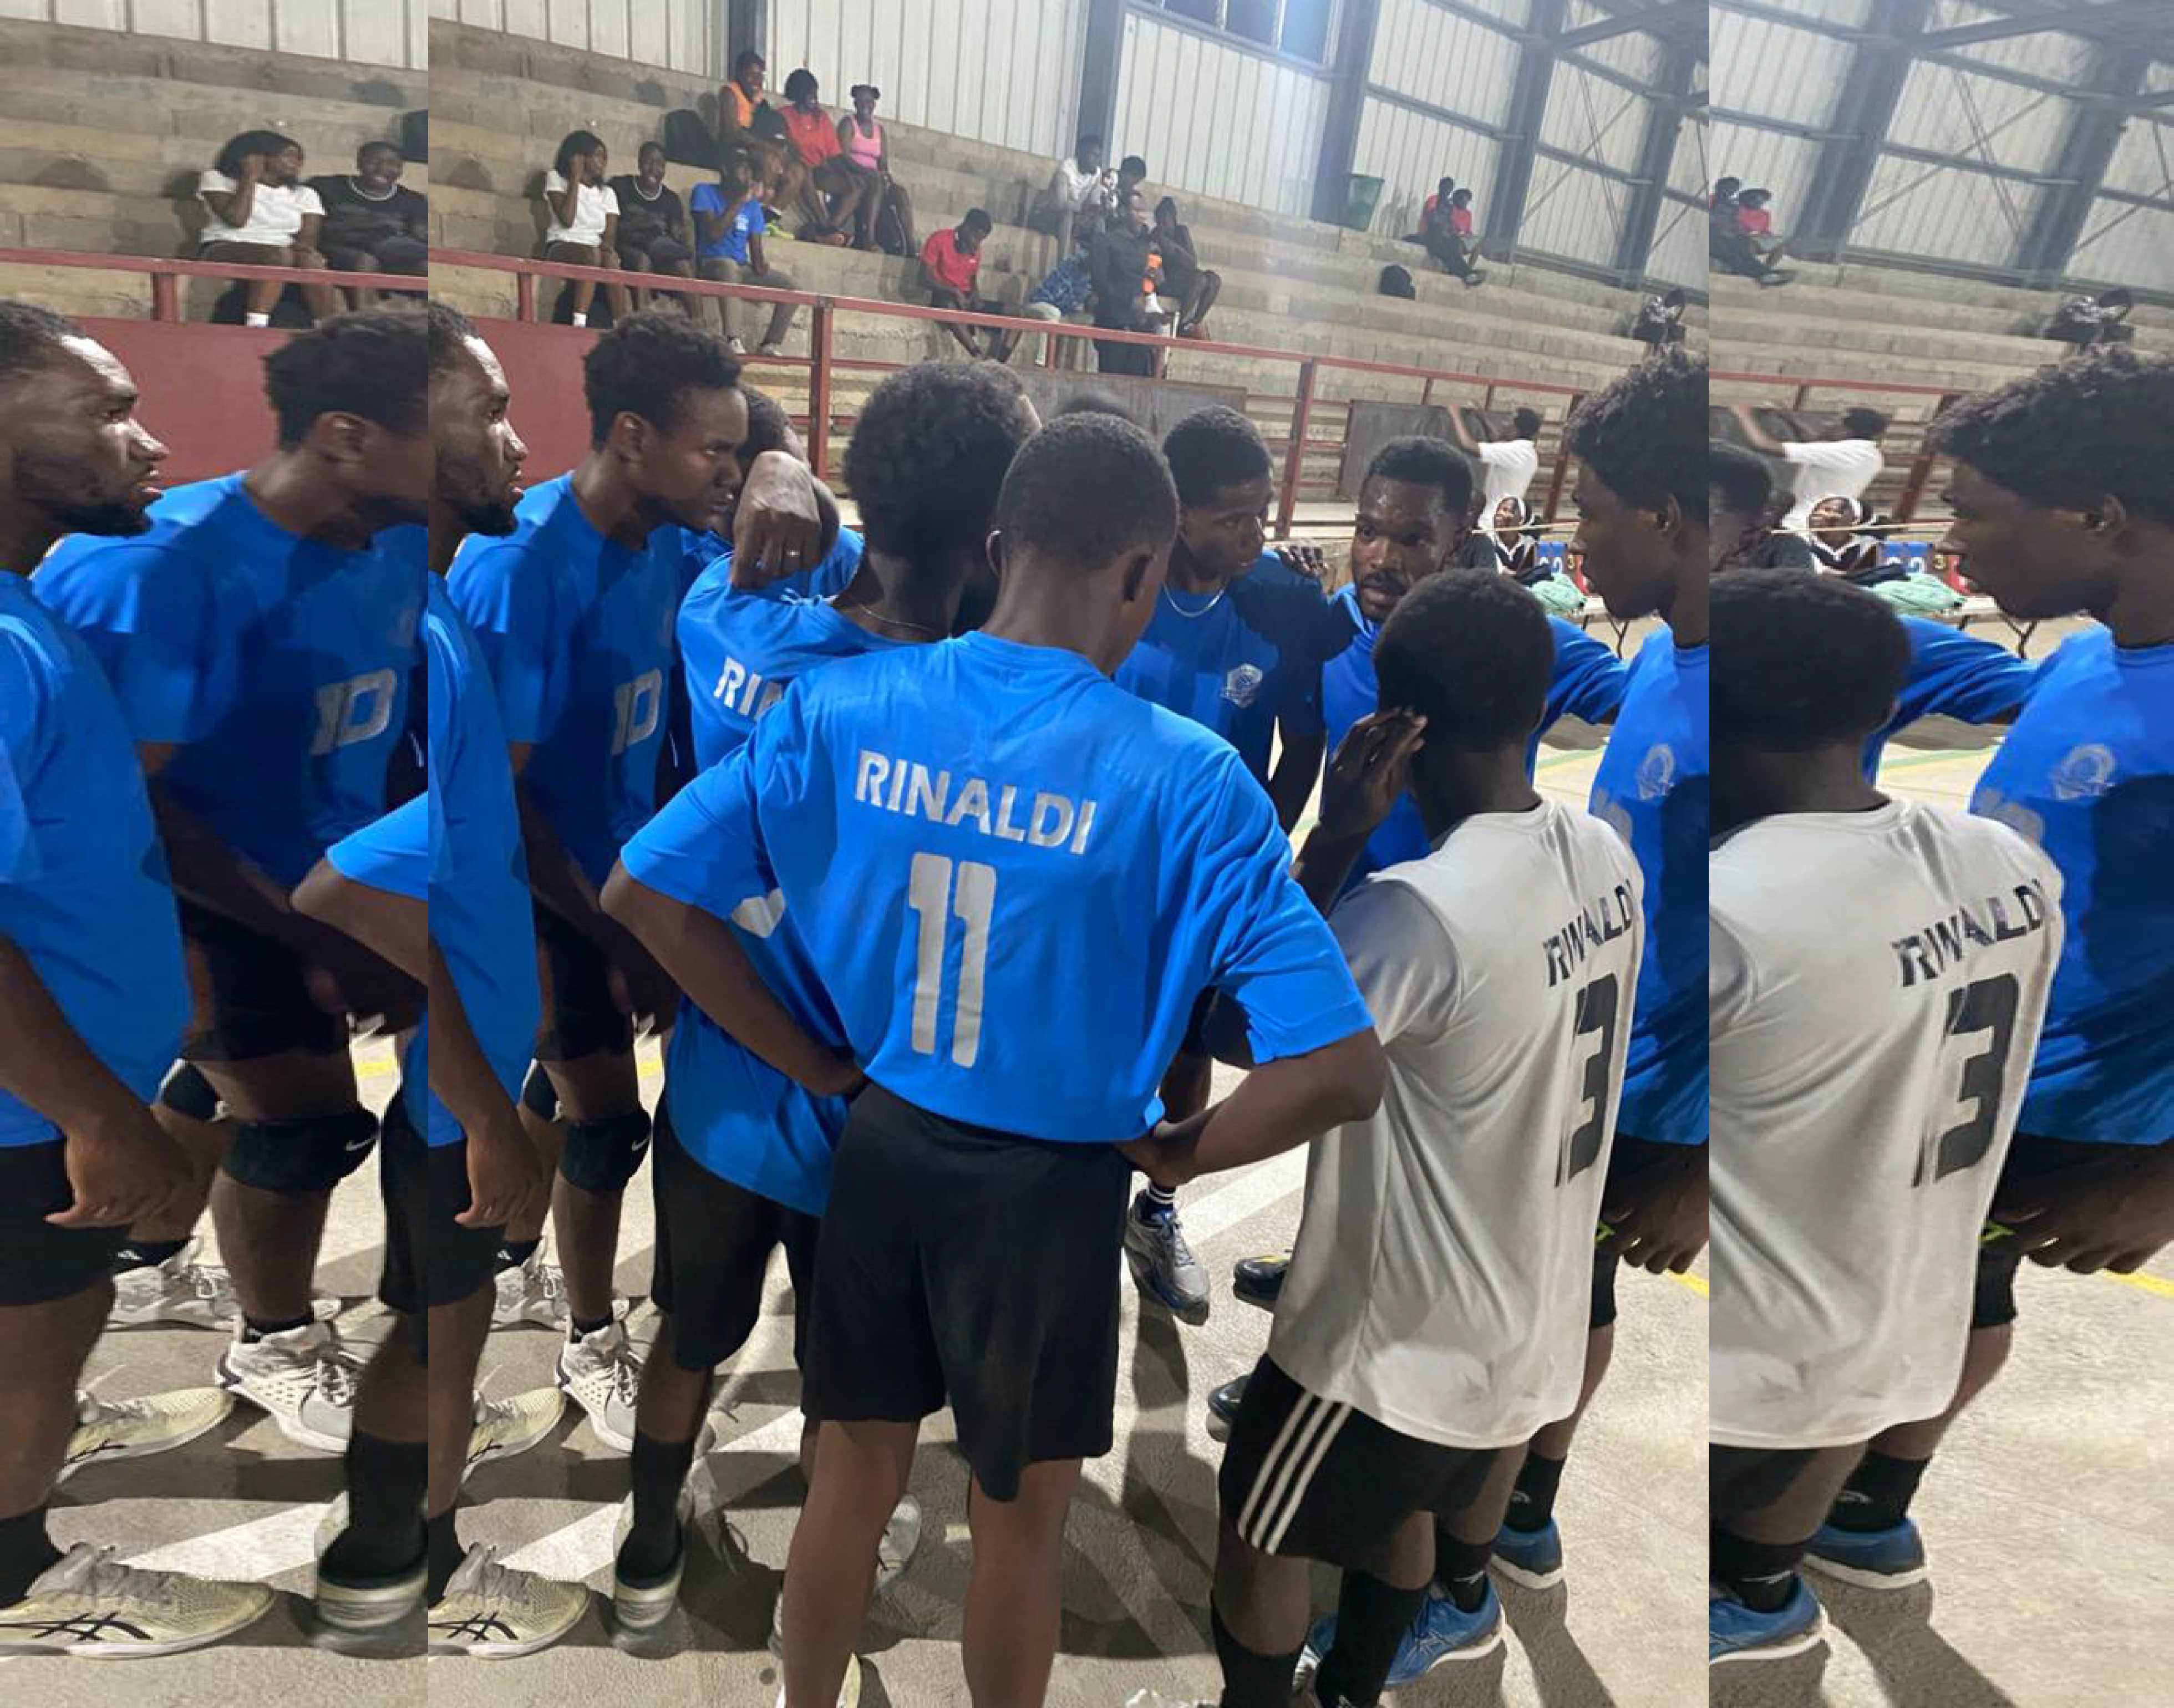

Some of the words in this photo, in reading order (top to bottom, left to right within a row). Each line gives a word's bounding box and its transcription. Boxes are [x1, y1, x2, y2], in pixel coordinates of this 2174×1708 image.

[309, 667, 397, 755] 10
[611, 668, 663, 755] 10
[855, 749, 1098, 855] RINALDI
[908, 851, 997, 1069] 11
[1554, 972, 1618, 1188] 3
[1912, 972, 2019, 1188] 3
